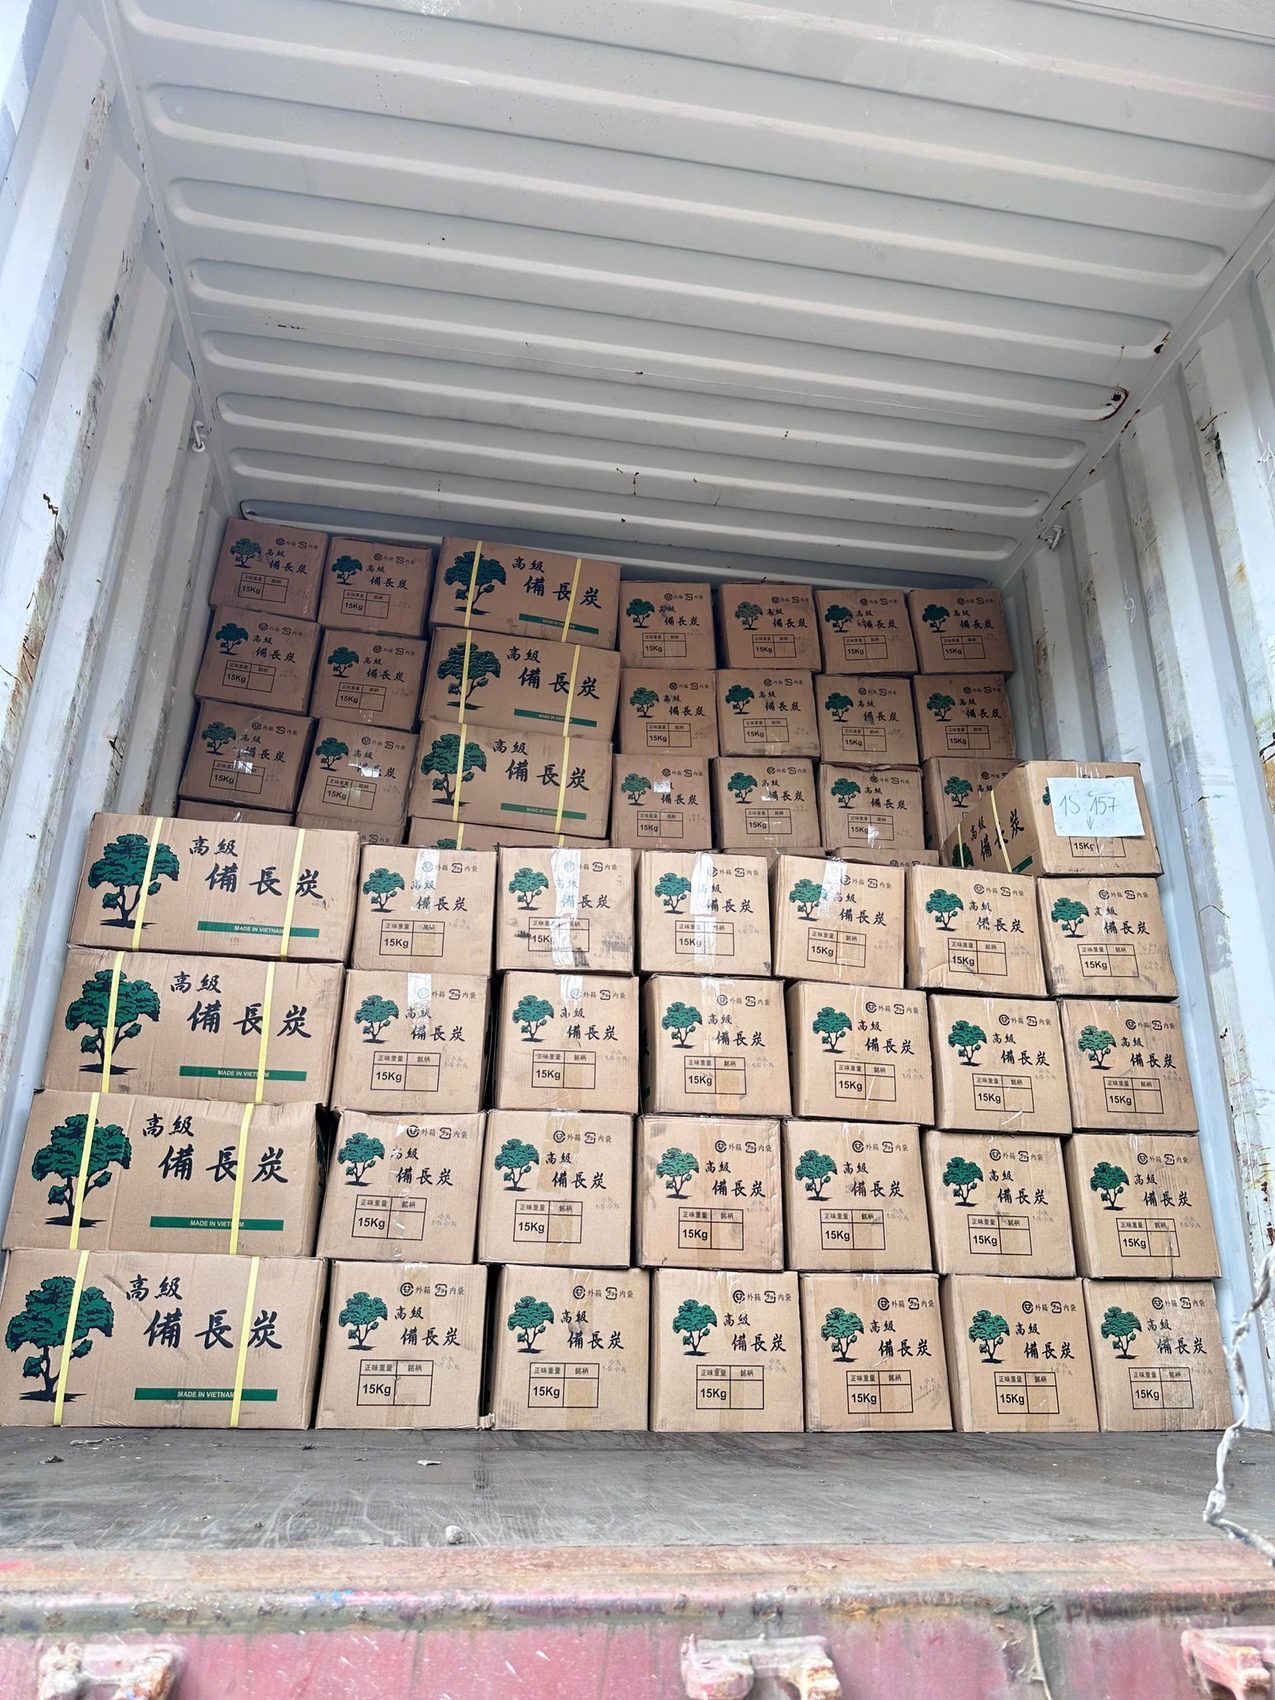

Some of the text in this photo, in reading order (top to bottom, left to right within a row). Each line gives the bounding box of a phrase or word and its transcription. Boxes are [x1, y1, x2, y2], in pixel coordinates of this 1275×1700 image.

[269, 559, 308, 575] 備長炭
[511, 556, 544, 574] 高級
[241, 583, 262, 595] 15Kg
[370, 576, 409, 590] 備長炭
[523, 575, 603, 610] 備長炭
[344, 601, 364, 613] 15Kg
[506, 646, 542, 664] 高級
[645, 644, 663, 654] 15Kg
[755, 646, 774, 657] 15Kg
[847, 647, 865, 657] 15Kg
[945, 646, 963, 656] 15Kg
[255, 647, 297, 664] 備長炭
[226, 672, 247, 684] 15Kg
[366, 668, 406, 683] 備長炭
[518, 667, 601, 700] 備長炭
[339, 693, 359, 705] 15Kg
[669, 704, 706, 718] 備長炭
[765, 699, 802, 713] 備長炭
[864, 709, 900, 722] 備長炭
[649, 734, 668, 744] 15Kg
[746, 730, 766, 740] 15Kg
[492, 739, 529, 756] 高級
[845, 738, 864, 748] 15Kg
[950, 737, 968, 747] 15Kg
[213, 774, 235, 786] 15Kg
[505, 758, 591, 792] 備長炭
[326, 790, 347, 802] 15Kg
[661, 792, 699, 806] 備長炭
[870, 796, 908, 811] 備長炭
[639, 824, 659, 834] 15Kg
[748, 820, 767, 831] 15Kg
[189, 835, 239, 858] 高級
[205, 862, 324, 899] 備長炭
[968, 900, 993, 912] 高級
[839, 908, 888, 926] 備長炭
[977, 916, 1025, 933] 備長炭
[1104, 917, 1151, 935] 備長炭
[384, 938, 409, 948] 15Kg
[678, 938, 702, 947] 15Kg
[811, 946, 834, 956] 15Kg
[952, 955, 975, 967] 15Kg
[1084, 959, 1107, 970] 15Kg
[170, 971, 222, 994] 高級
[560, 1007, 585, 1018] 高級
[186, 1000, 312, 1039] 備長炭
[708, 1014, 733, 1025] 高級
[858, 1020, 882, 1032] 高級
[410, 1024, 466, 1042] 備長炭
[566, 1024, 618, 1041] 備長炭
[716, 1030, 766, 1047] 備長炭
[992, 1033, 1016, 1045] 高級
[1121, 1036, 1144, 1048] 高級
[866, 1038, 915, 1055] 備長炭
[1000, 1049, 1050, 1067] 備長炭
[1130, 1052, 1177, 1069] 備長炭
[376, 1072, 402, 1082] 15Kg
[536, 1069, 560, 1080] 15Kg
[688, 1076, 712, 1086] 15Kg
[838, 1080, 862, 1090] 15Kg
[977, 1092, 1001, 1103] 15Kg
[1109, 1094, 1132, 1105] 15Kg
[143, 1113, 195, 1138] 高級
[158, 1144, 289, 1183] 備長炭
[545, 1152, 573, 1165] 高級
[705, 1160, 731, 1174] 高級
[843, 1162, 869, 1174] 高級
[396, 1167, 454, 1186] 備長炭
[552, 1171, 607, 1190] 備長炭
[989, 1170, 1014, 1182] 高級
[1134, 1173, 1158, 1185] 高級
[712, 1180, 766, 1197] 備長炭
[850, 1180, 904, 1197] 備長炭
[998, 1188, 1048, 1205] 備長炭
[1144, 1191, 1192, 1207] 備長炭
[358, 1216, 385, 1230] 15Kg
[518, 1221, 545, 1233] 15Kg
[682, 1228, 708, 1240] 15Kg
[825, 1230, 850, 1241] 15Kg
[973, 1235, 997, 1246] 15Kg
[1123, 1238, 1146, 1249] 15Kg
[126, 1274, 183, 1301] 高級
[415, 1285, 431, 1295] 外箱
[587, 1288, 602, 1297] 外箱
[394, 1306, 424, 1320] 高級
[560, 1309, 588, 1324] 高級
[723, 1313, 751, 1326] 高級
[870, 1319, 896, 1332] 高級
[1146, 1319, 1172, 1331] 高級
[143, 1307, 283, 1350] 備長炭
[1015, 1322, 1041, 1335] 高級
[400, 1327, 461, 1347] 備長炭
[567, 1330, 625, 1350] 備長炭
[731, 1333, 786, 1352] 備長炭
[879, 1339, 932, 1357] 備長炭
[1024, 1342, 1075, 1360] 備長炭
[1157, 1336, 1207, 1354] 備長炭
[364, 1363, 423, 1372] 正味重量 銘柄
[534, 1366, 589, 1375] 正味重量 銘柄
[740, 1369, 754, 1377] 銘柄
[850, 1374, 901, 1382] 正味重量 銘柄
[998, 1375, 1023, 1383] 正味重量
[1132, 1370, 1157, 1379] 正味重量
[362, 1383, 391, 1396] 15Kg
[532, 1385, 560, 1398] 15Kg
[700, 1388, 727, 1400] 15Kg
[1135, 1389, 1160, 1400] 15Kg
[851, 1392, 877, 1404] 15Kg
[999, 1394, 1025, 1405] 15Kg
